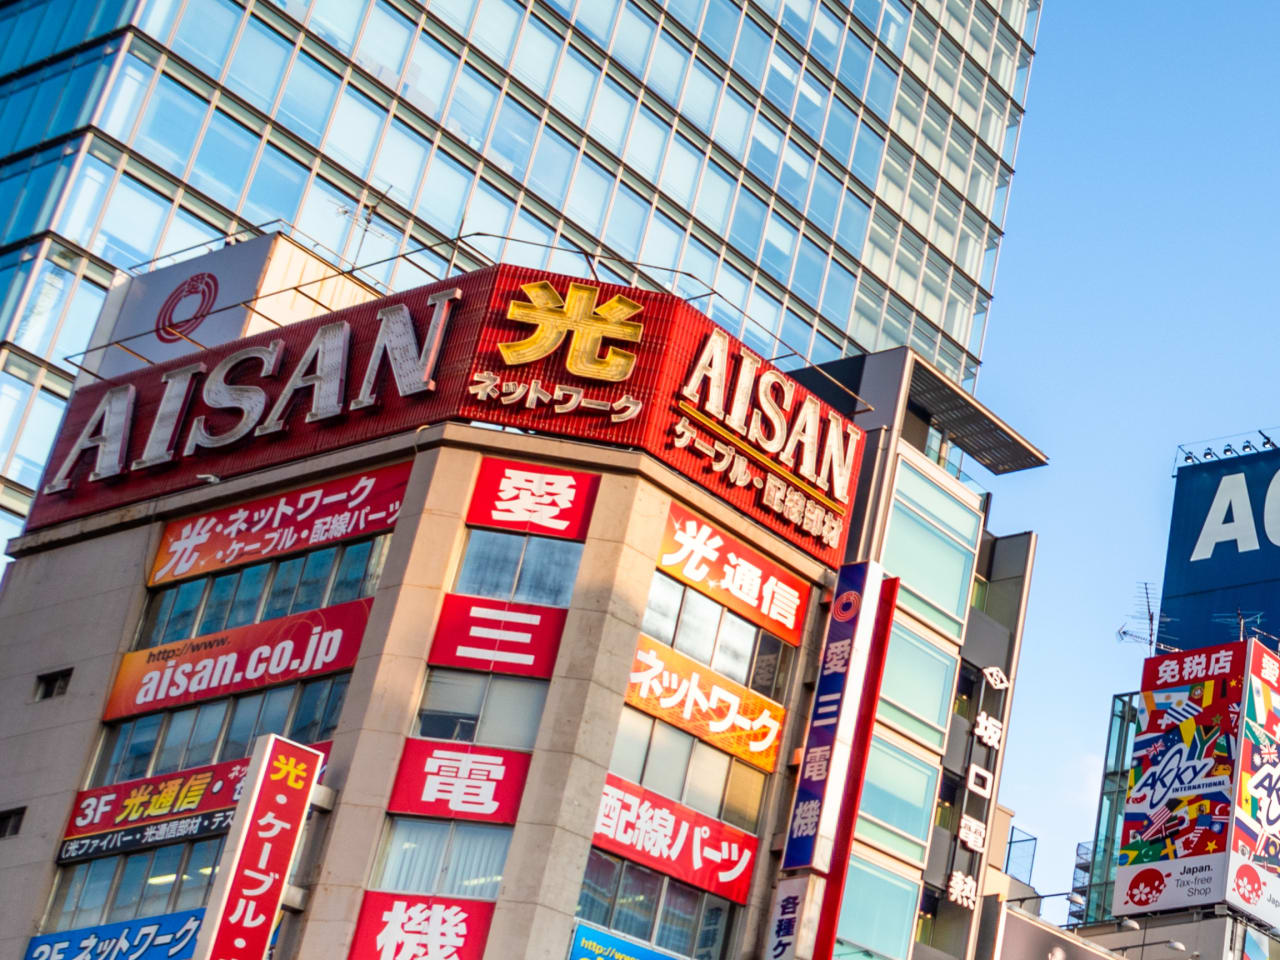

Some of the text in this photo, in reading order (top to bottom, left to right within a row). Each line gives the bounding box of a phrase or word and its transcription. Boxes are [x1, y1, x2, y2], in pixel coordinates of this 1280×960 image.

[498, 281, 644, 383] 光
[45, 289, 462, 494] AISAN
[469, 371, 643, 423] ネットワーク
[683, 330, 862, 505] AISAN
[673, 417, 843, 549] ケーブル・配線部材
[661, 518, 801, 629] 光通信
[135, 624, 342, 705] aisan.co.jp
[146, 635, 231, 664] http://www.
[1156, 650, 1233, 685] 免税店
[630, 649, 781, 753] ネットワーク
[792, 638, 851, 839] 愛三電機
[75, 794, 115, 826] 3F
[1172, 779, 1225, 793] INTERNATIONAL
[594, 784, 751, 882] 配線パーツ
[1180, 864, 1213, 876] Japan.
[1175, 876, 1212, 888] Tax-free
[1187, 887, 1211, 897] Shop
